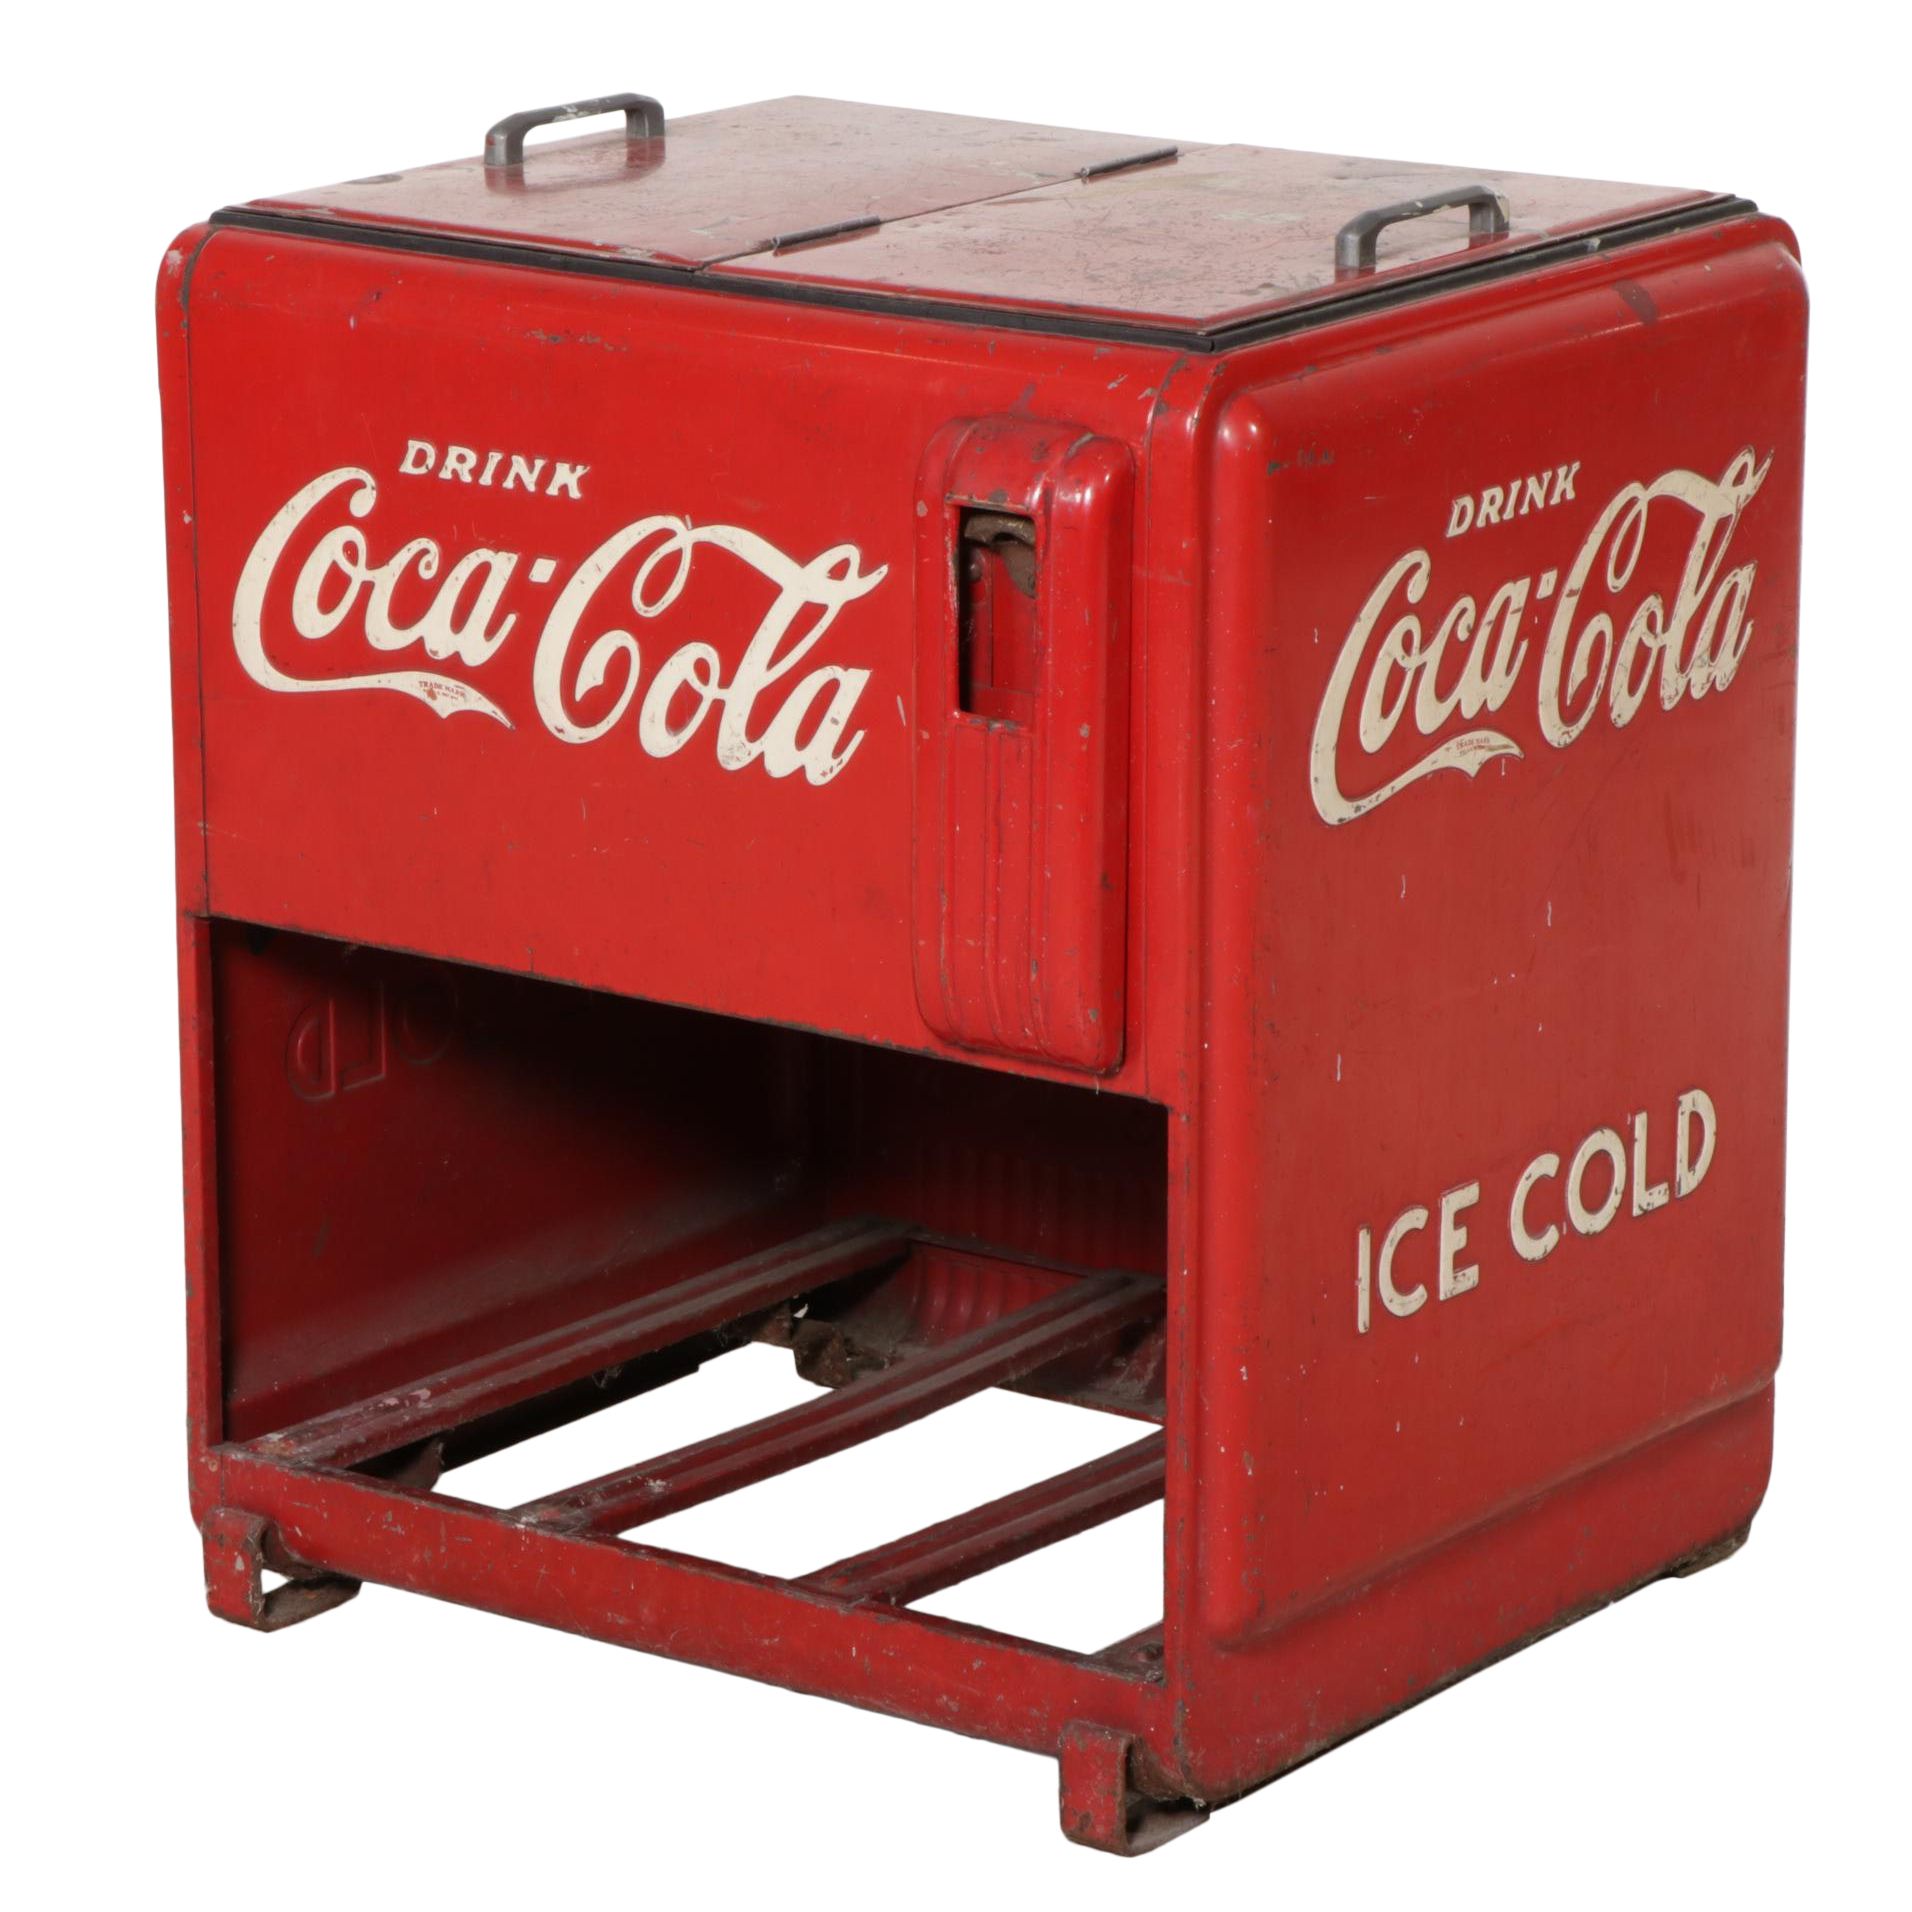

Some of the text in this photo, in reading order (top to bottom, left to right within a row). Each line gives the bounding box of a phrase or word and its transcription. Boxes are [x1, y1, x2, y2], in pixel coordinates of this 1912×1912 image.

[399, 439, 591, 500] DRINK
[1446, 461, 1580, 538] DRINK
[232, 467, 889, 786] Coca-Cola
[1309, 446, 1774, 826] Coca-Cola
[1357, 1088, 1717, 1334] ICE COLD
